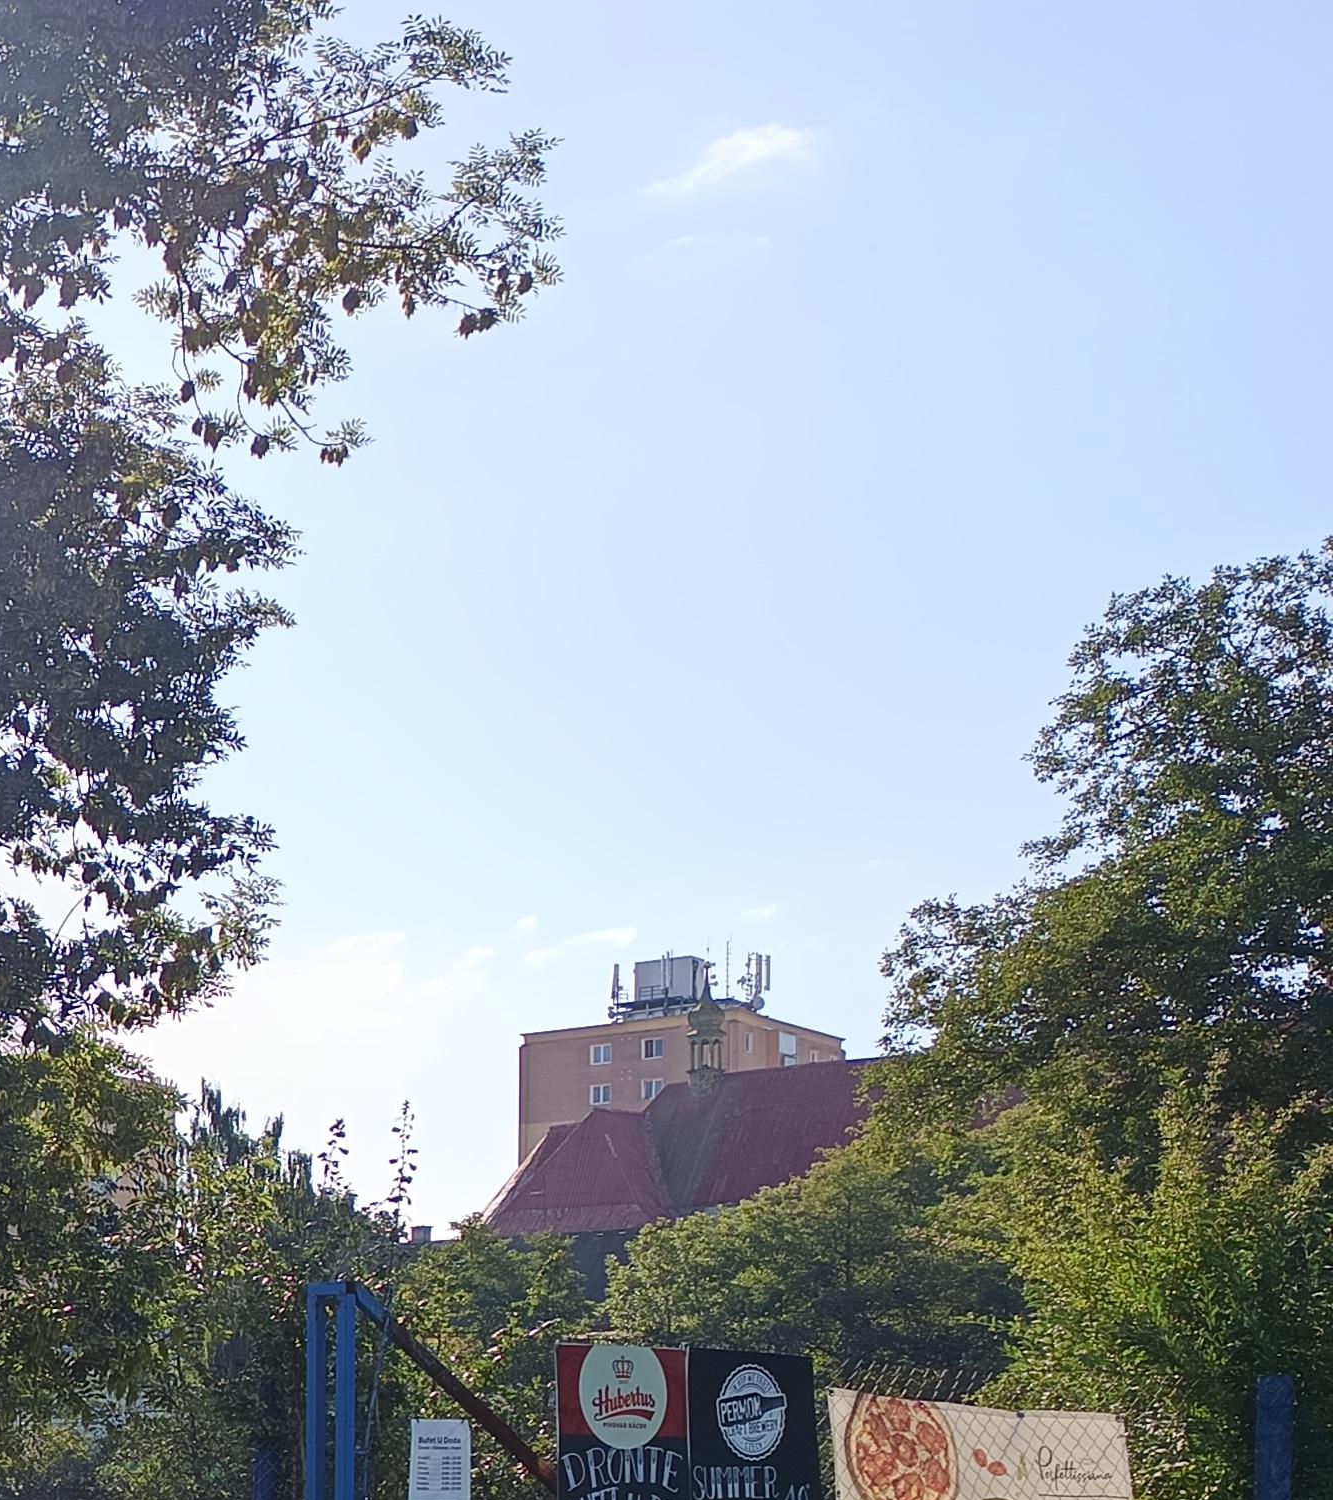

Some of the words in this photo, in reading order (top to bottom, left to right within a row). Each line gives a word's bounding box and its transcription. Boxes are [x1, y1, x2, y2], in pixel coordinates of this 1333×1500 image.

[592, 1384, 655, 1416] Hubertus
[561, 1446, 683, 1493] DRONTE
[693, 1466, 780, 1500] SUMMER
